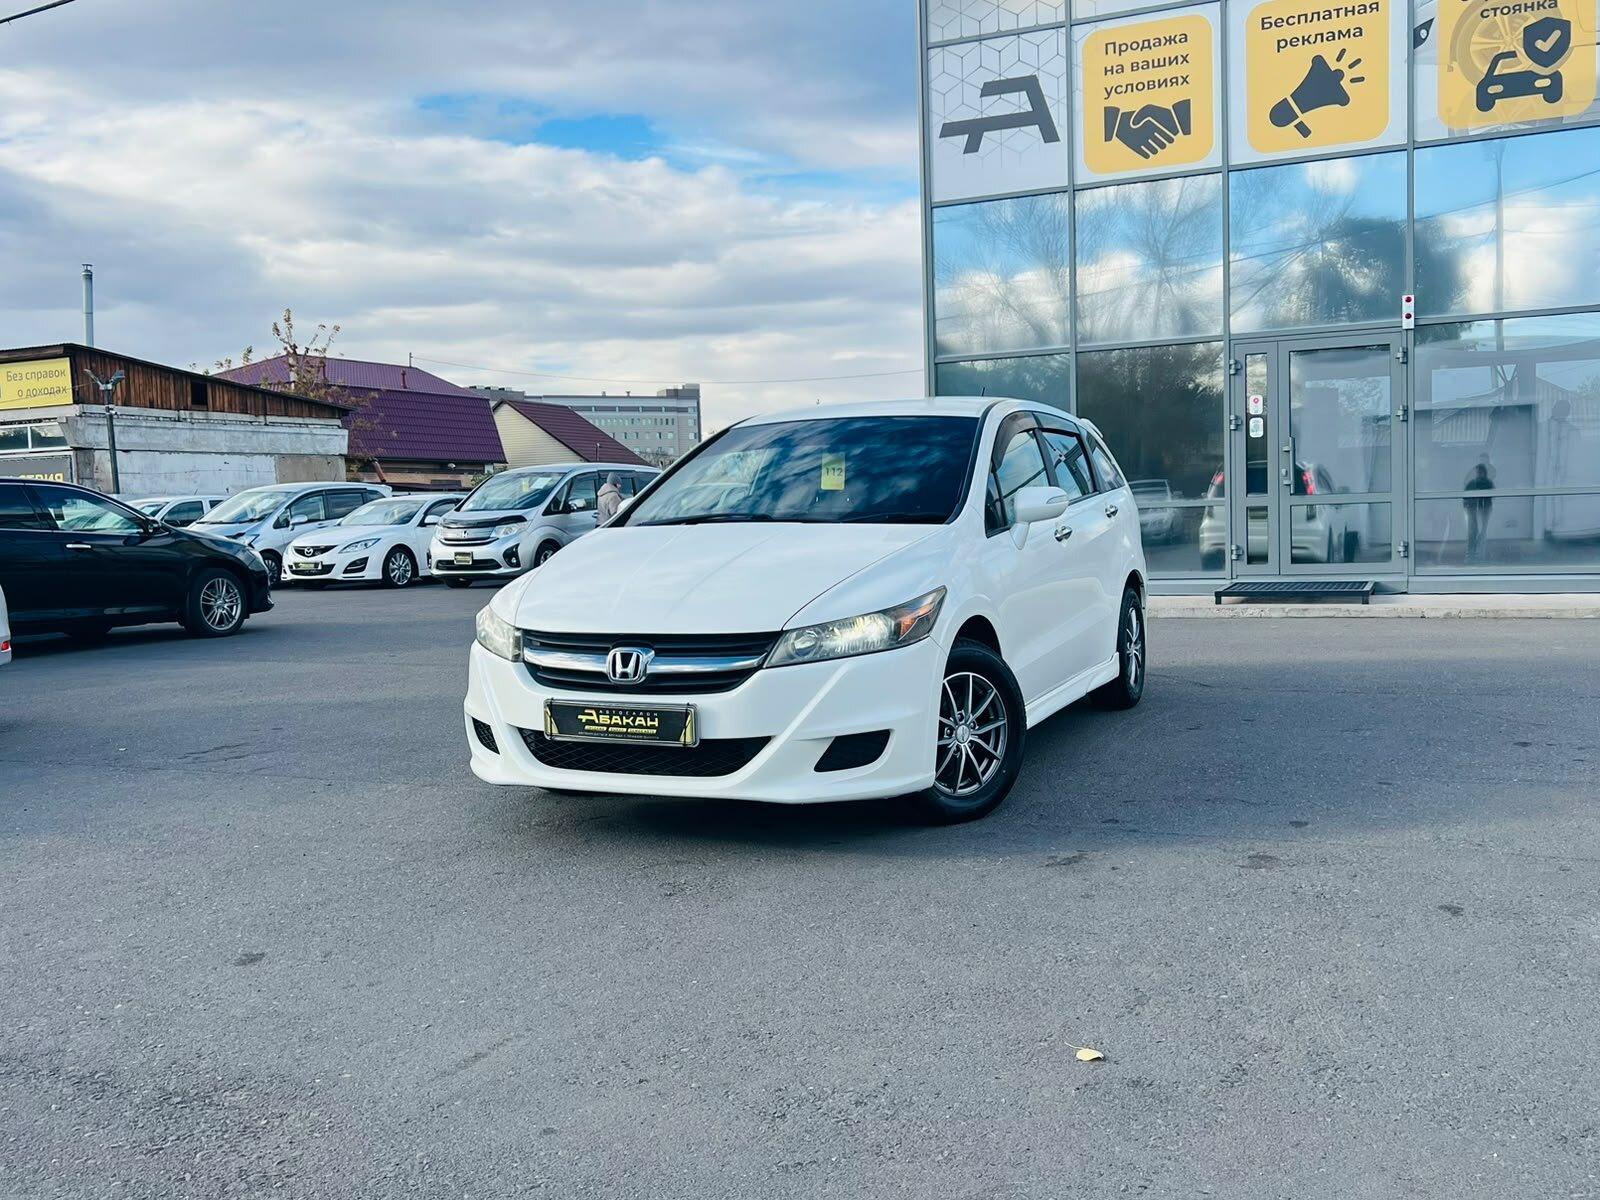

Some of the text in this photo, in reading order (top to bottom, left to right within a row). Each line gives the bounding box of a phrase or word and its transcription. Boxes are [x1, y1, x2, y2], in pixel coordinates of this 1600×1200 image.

[1261, 1, 1380, 31] Бесплатная
[1480, 0, 1558, 19] стоянка
[1105, 33, 1188, 56] Продажа
[1276, 26, 1363, 53] реклама
[1104, 53, 1190, 76] на ваших
[1103, 74, 1190, 100] условиях
[6, 369, 66, 382] Без справок
[17, 385, 67, 399] о доходах
[825, 466, 843, 477] 112
